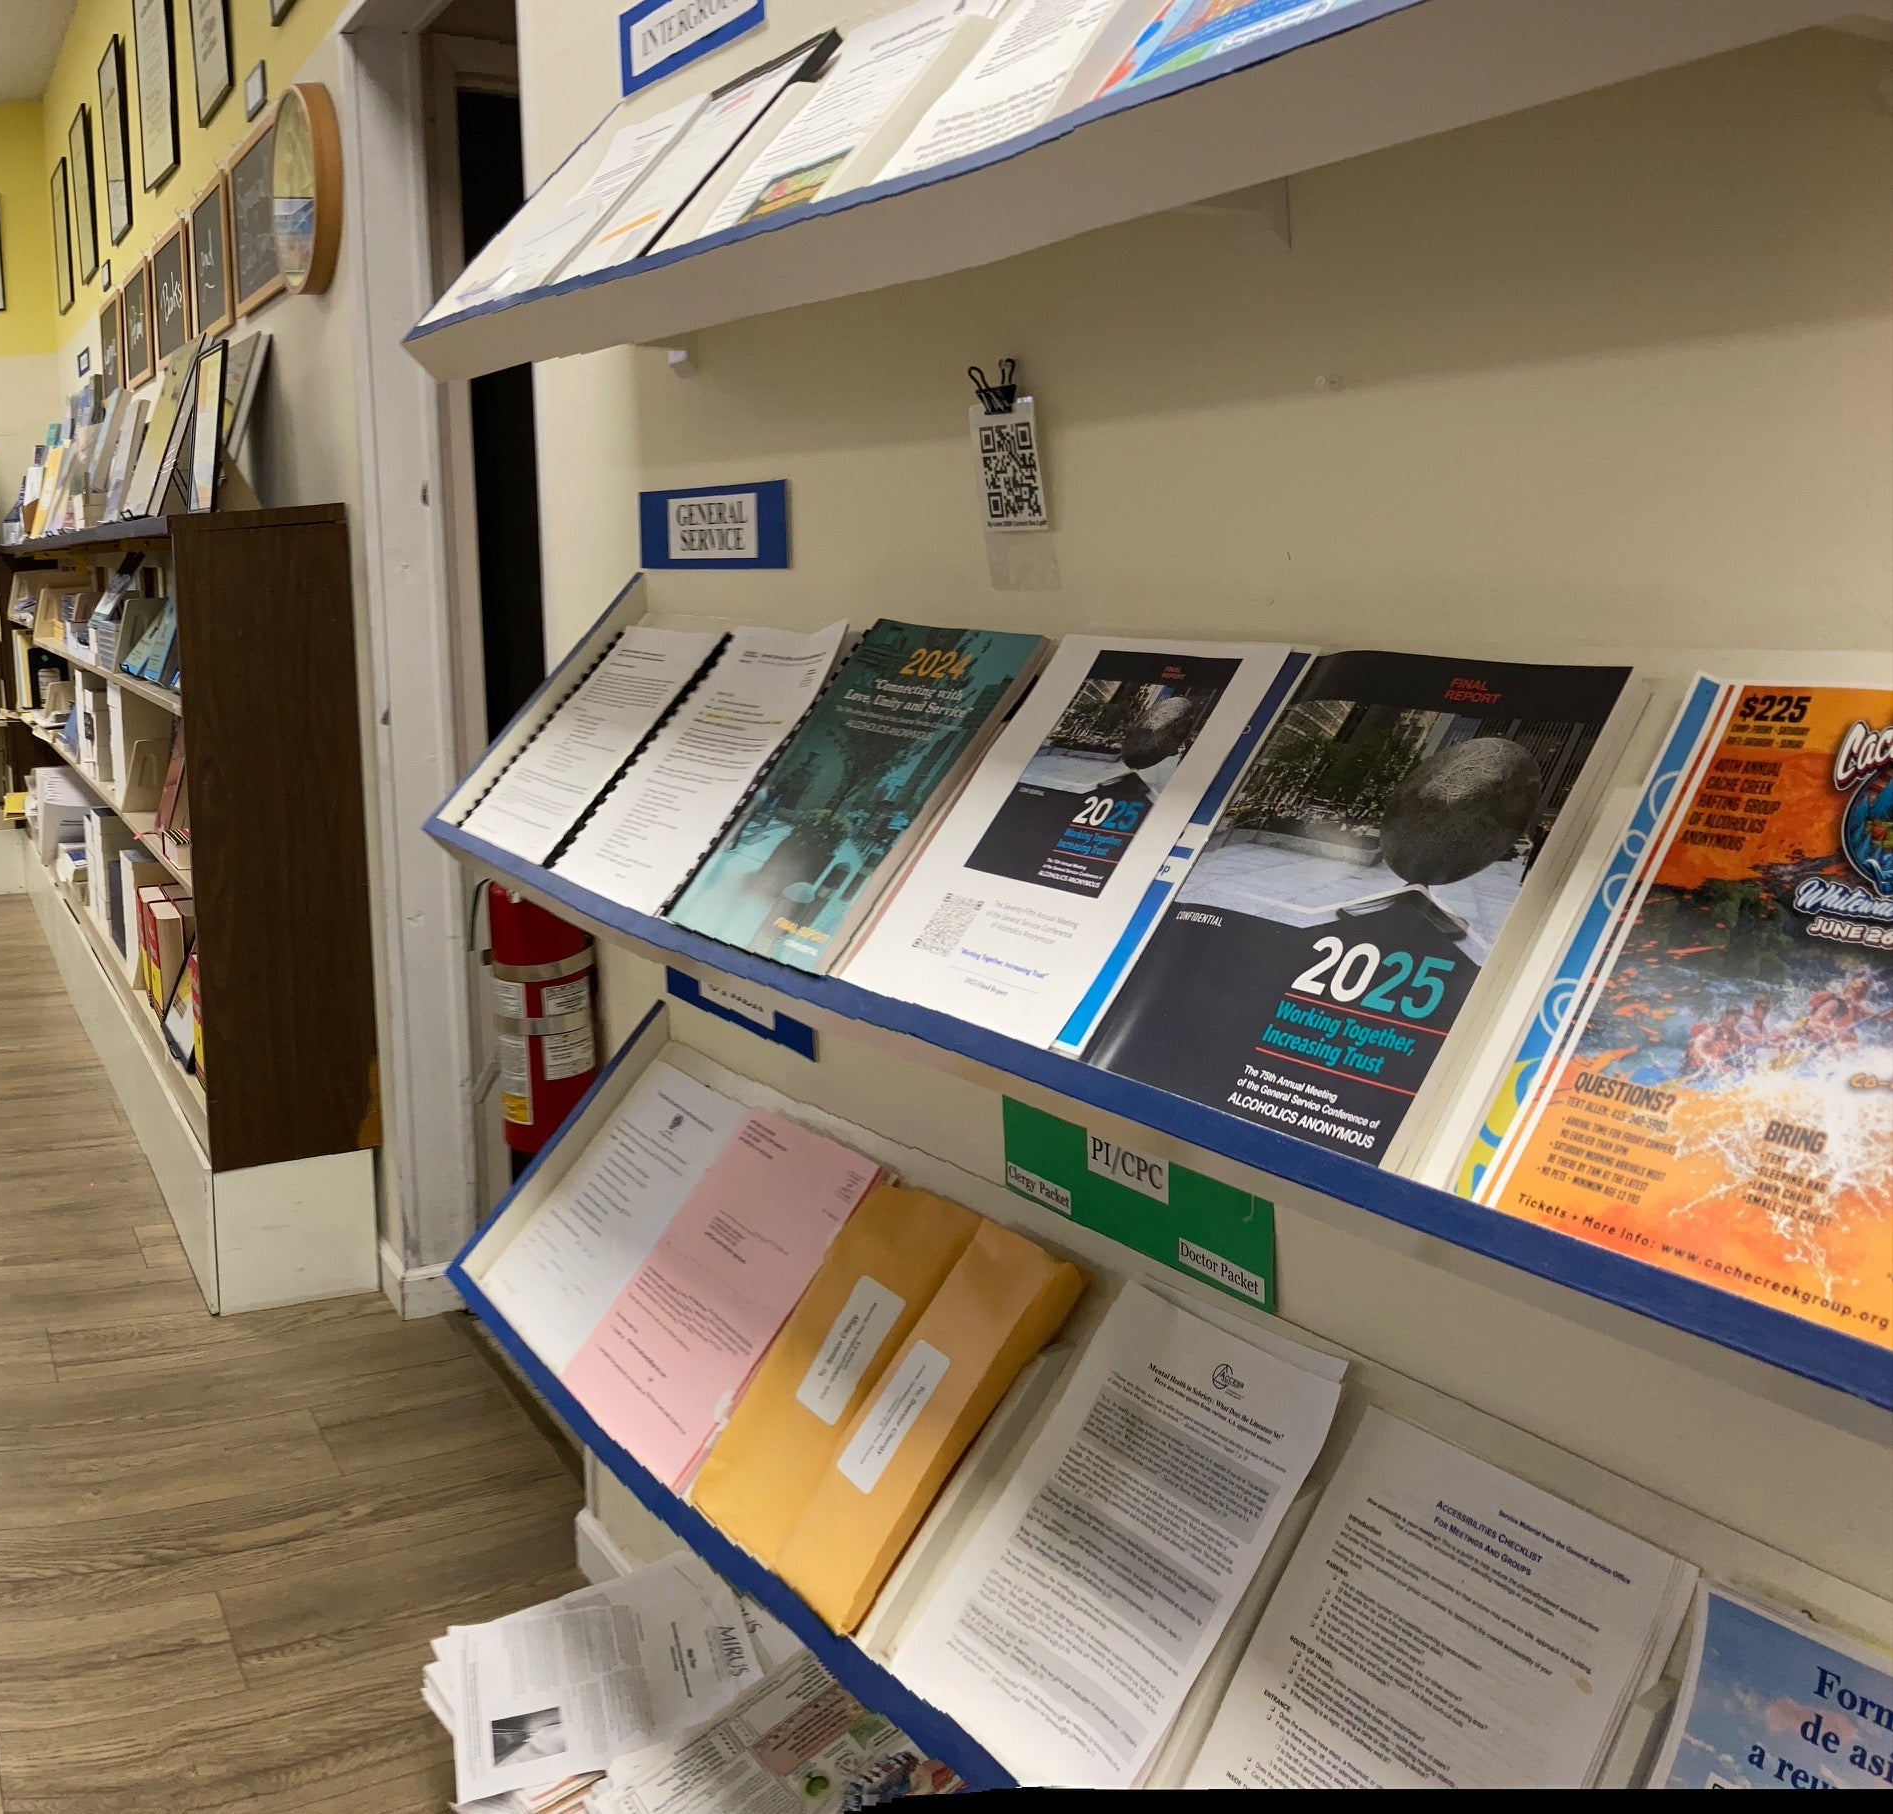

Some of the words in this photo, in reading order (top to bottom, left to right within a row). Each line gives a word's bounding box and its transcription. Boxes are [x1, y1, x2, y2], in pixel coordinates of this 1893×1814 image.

[676, 502, 749, 529] GENERAL
[678, 527, 746, 553] SERVICE
[900, 649, 972, 680] 2024
[937, 689, 964, 700] with
[1444, 687, 1501, 705] REPORT
[1451, 677, 1489, 693] FINAL
[844, 689, 871, 703] Love,
[873, 694, 903, 710] Unity
[904, 700, 923, 712] and
[925, 702, 974, 718] Service"
[1739, 694, 1811, 723] $225
[1175, 910, 1223, 928] CONFIDENTIAL
[1807, 917, 1866, 940] JUNE
[1291, 936, 1455, 1019] 2025
[1276, 1001, 1342, 1038] Working
[1343, 1018, 1415, 1056] Together,
[1262, 1024, 1342, 1066] Increasing
[1343, 1046, 1384, 1075] Trust
[1245, 1065, 1257, 1076] The
[1259, 1070, 1276, 1083] 75th
[1278, 1075, 1305, 1091] Annual
[1305, 1083, 1337, 1101] Meeting
[1573, 1071, 1675, 1114] QUESTIONS?
[1228, 1092, 1297, 1124] ALCOHOLICS
[1297, 1117, 1375, 1149] ANONYMOUS
[1237, 1078, 1246, 1087] of
[1246, 1081, 1259, 1092] the
[1260, 1084, 1291, 1102] General
[1291, 1094, 1320, 1112] Service
[1322, 1105, 1368, 1127] Conference
[1370, 1120, 1381, 1129] of
[1765, 1120, 1827, 1154] BRING
[1092, 1136, 1163, 1190] PI/CPC
[1009, 1165, 1036, 1192] Clergy
[1039, 1181, 1070, 1208] Packet
[1180, 1241, 1218, 1272] Doctor
[1220, 1262, 1259, 1295] Packet
[1517, 1193, 1567, 1219] Tickets
[1583, 1215, 1617, 1236] More
[1661, 1243, 1889, 1329] www.cachecreekgroup.org
[1800, 1713, 1840, 1753] de
[1748, 1744, 1766, 1769] a
